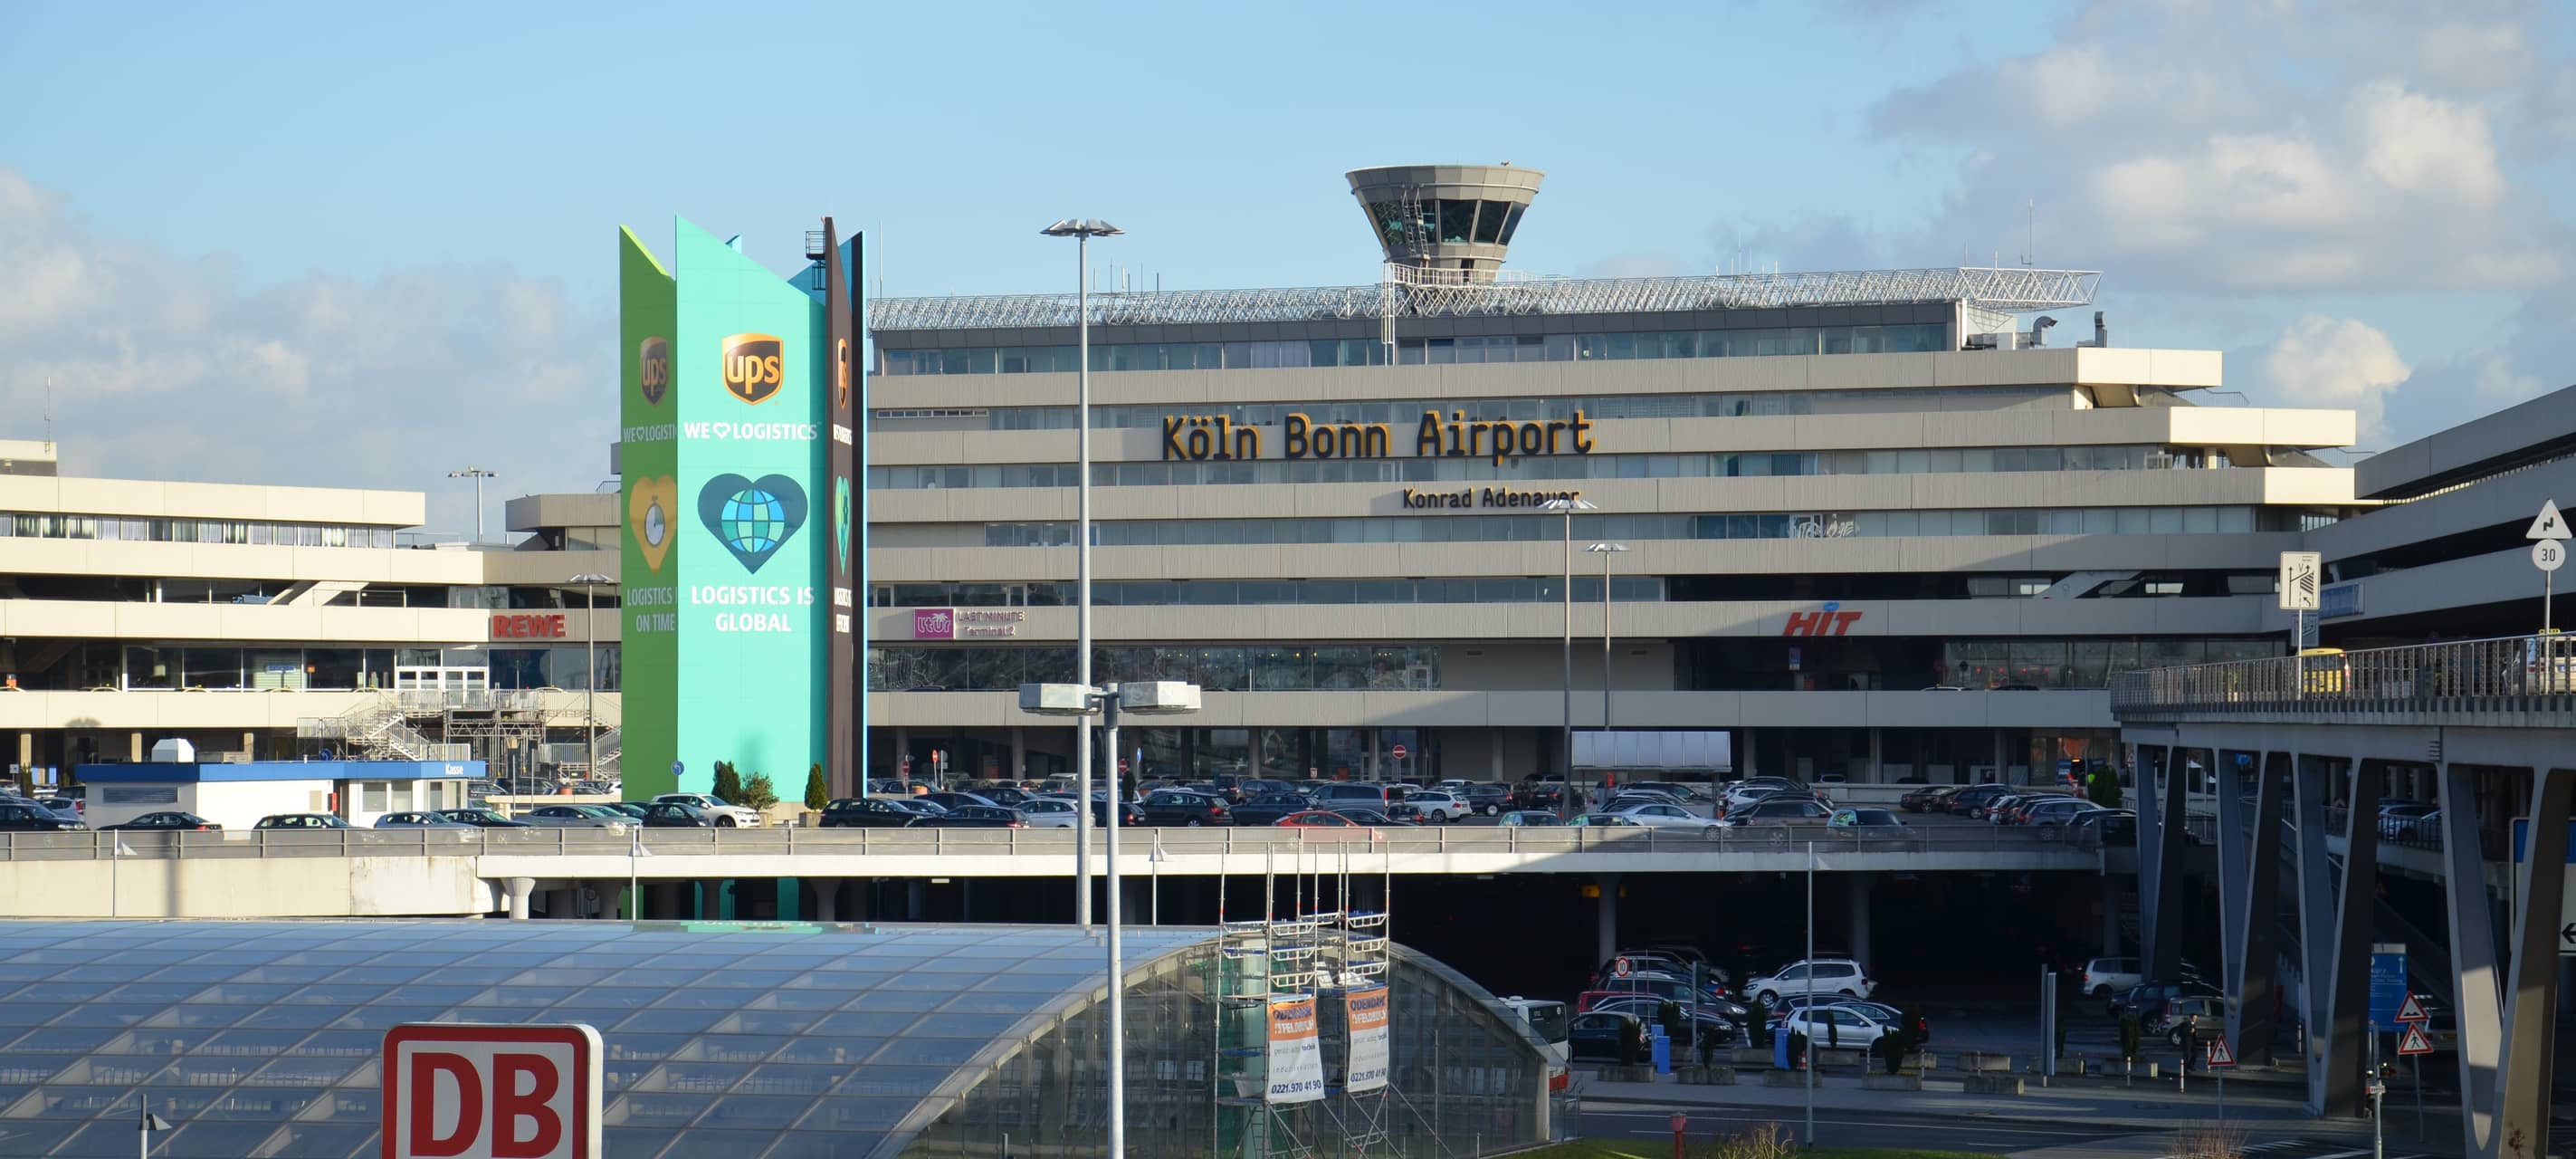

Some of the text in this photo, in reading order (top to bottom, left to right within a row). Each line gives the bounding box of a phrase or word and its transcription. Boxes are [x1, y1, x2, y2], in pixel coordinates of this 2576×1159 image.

[641, 358, 667, 396] ups
[726, 355, 779, 394] ups
[623, 423, 676, 443] WE LOGISTI
[683, 422, 711, 439] WE
[732, 423, 817, 440] LOGISTICS
[1162, 409, 1596, 466] Köln Bonn Airport
[1403, 487, 1474, 508] Konrad
[2541, 548, 2556, 562] 30
[626, 587, 673, 607] LOGISTICS
[692, 586, 790, 605] LOGISTICS
[797, 586, 814, 605] IS
[492, 614, 567, 637] REWE
[636, 613, 675, 633] ON TIME
[715, 612, 791, 632] GLOBAL
[958, 611, 1025, 622] LAST MINUTE
[1008, 626, 1016, 637] 2
[445, 762, 463, 775] Kasse
[410, 1052, 562, 1159] DB
